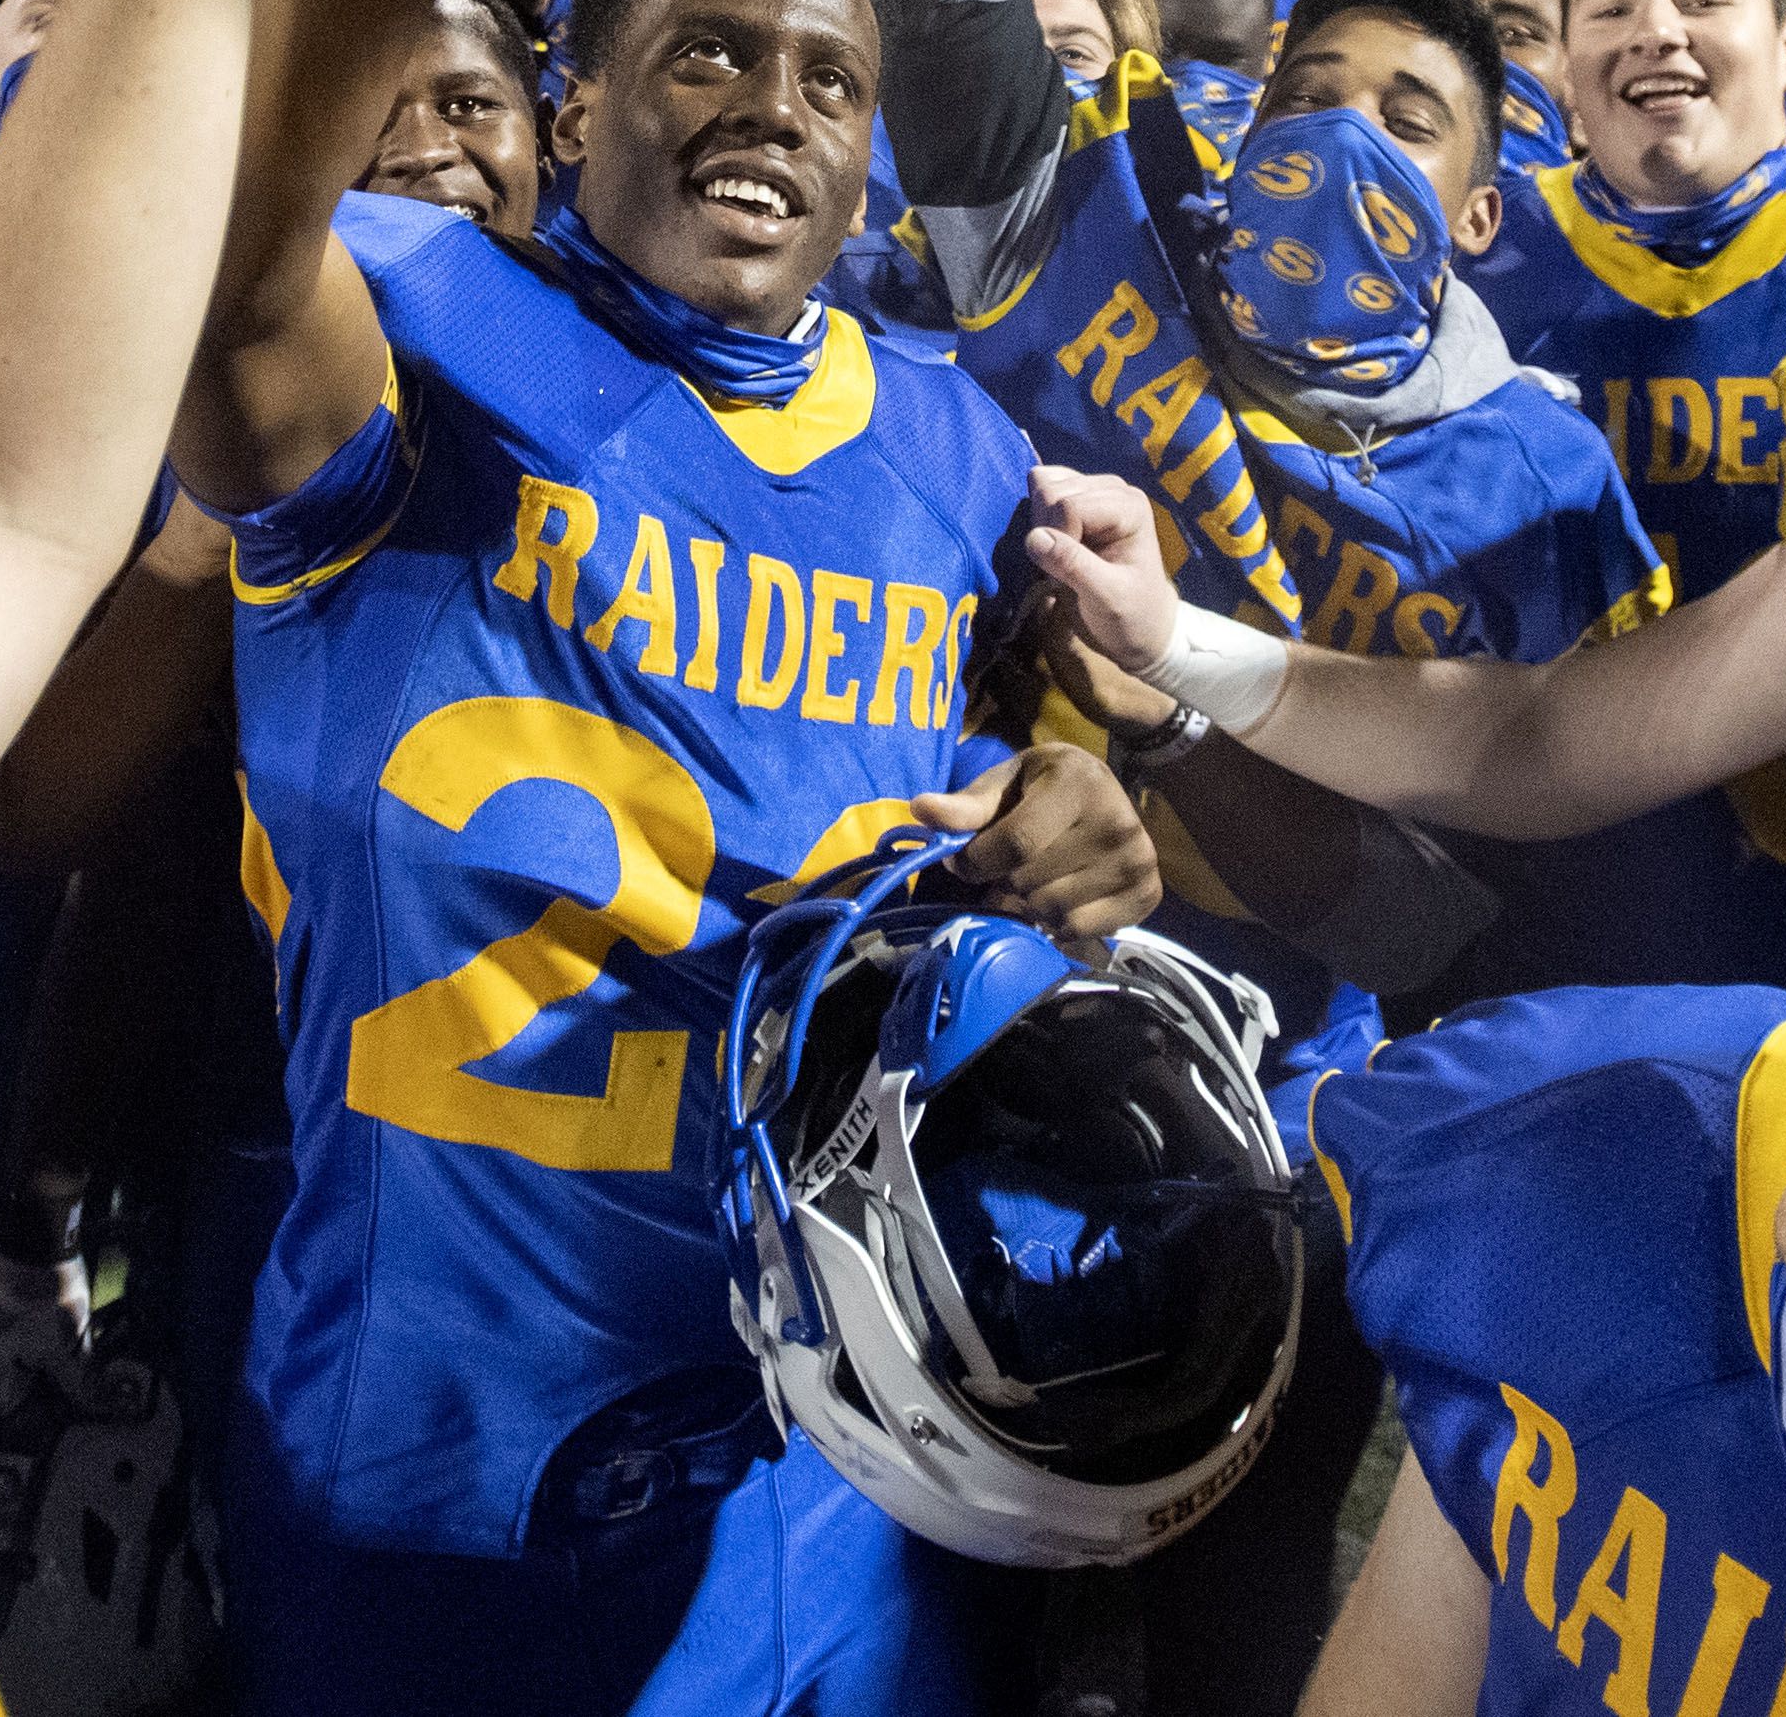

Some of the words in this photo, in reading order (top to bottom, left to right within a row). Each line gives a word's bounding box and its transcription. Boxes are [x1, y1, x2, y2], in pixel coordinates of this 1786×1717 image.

[1363, 188, 1417, 256] S
[493, 474, 976, 730] RAIDERS
[795, 1097, 873, 1196] XENITH
